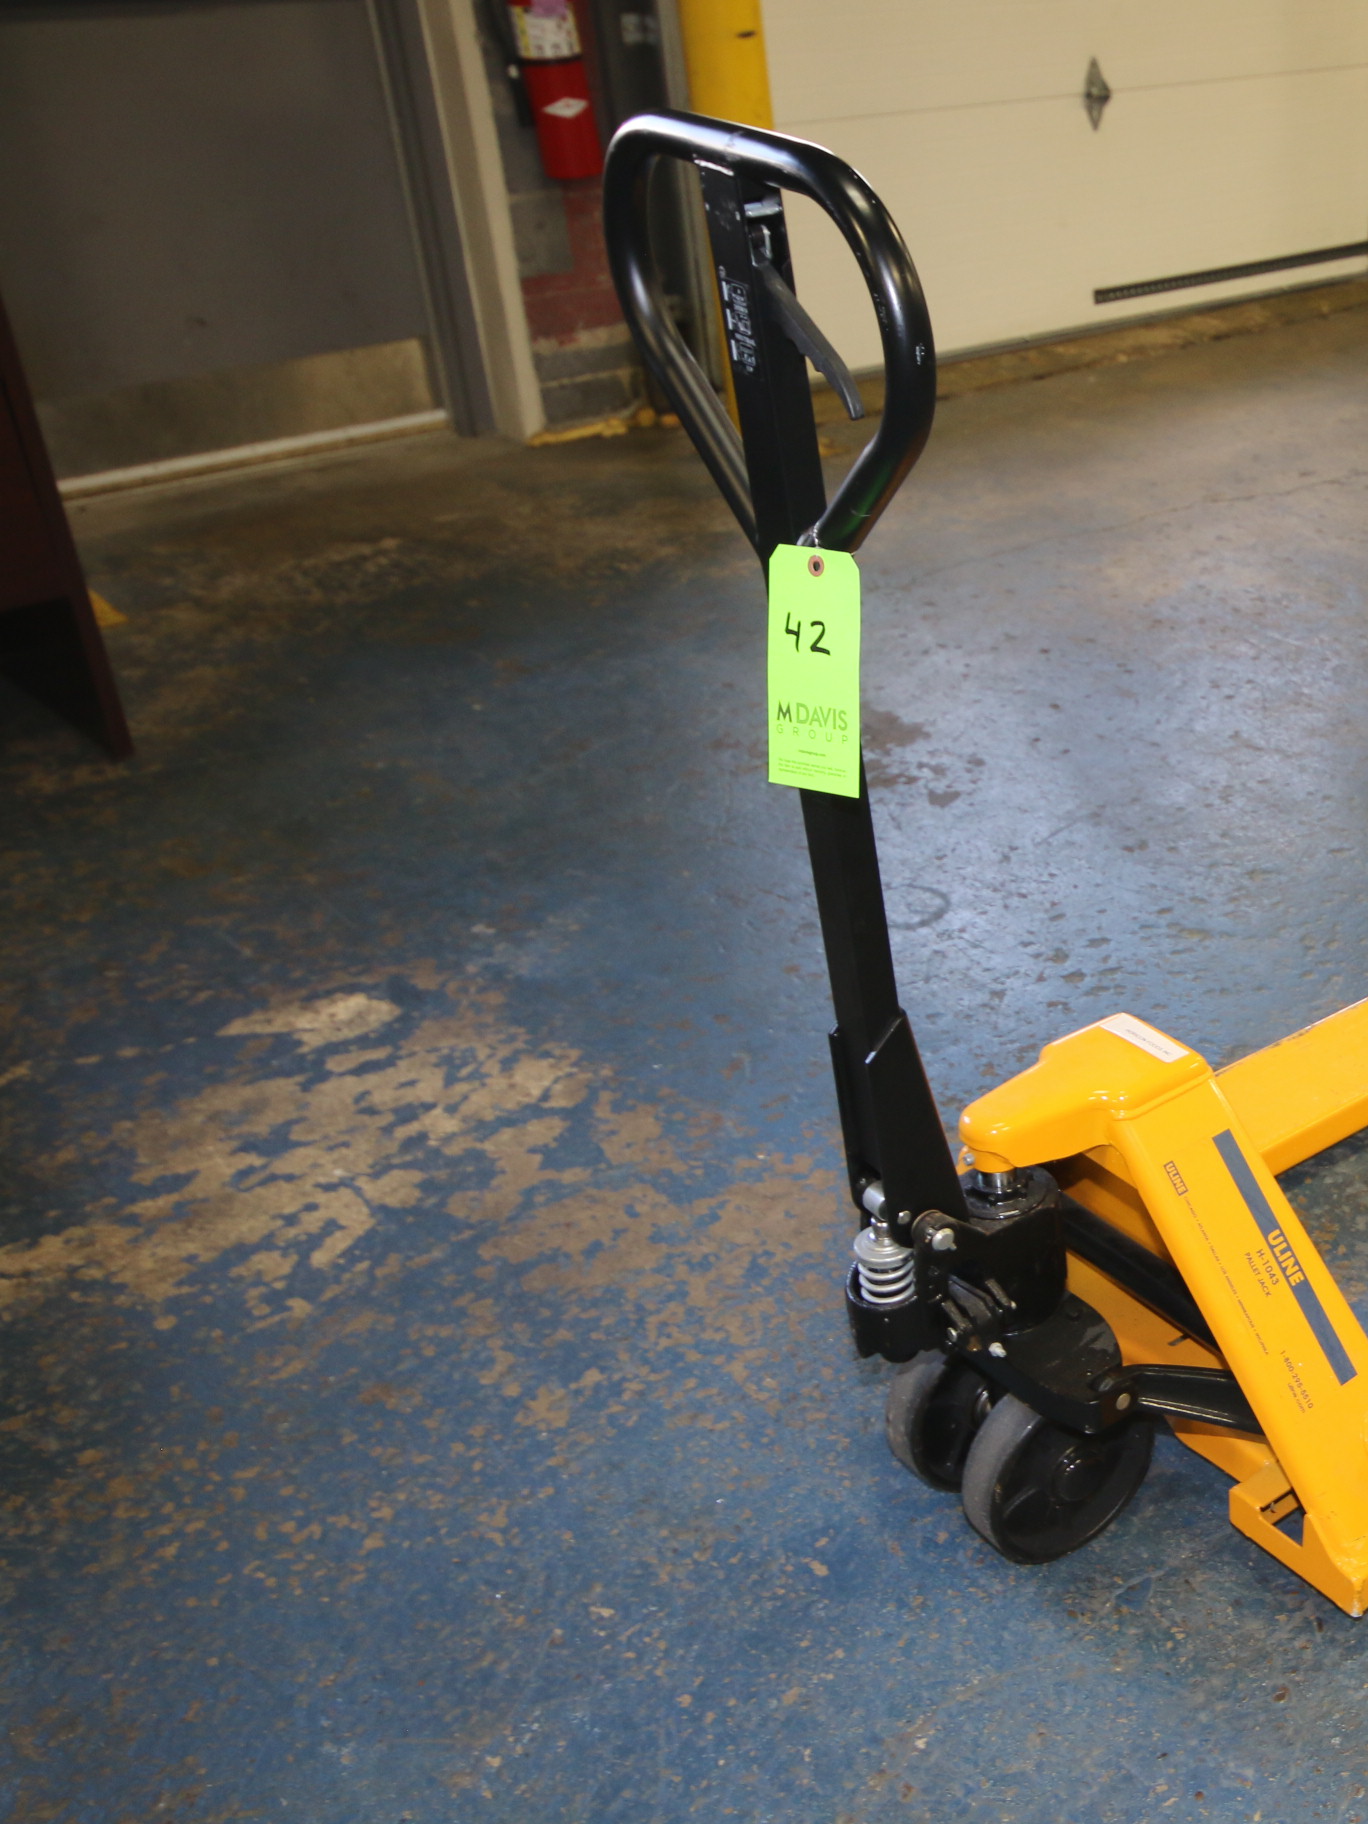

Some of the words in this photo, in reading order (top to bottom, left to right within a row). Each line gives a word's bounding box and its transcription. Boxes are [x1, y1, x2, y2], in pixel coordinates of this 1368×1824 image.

[784, 611, 831, 656] 42
[776, 723, 849, 745] GROUP
[1164, 1161, 1187, 1195] ULINE
[1244, 1252, 1261, 1278] PALLET
[1258, 1278, 1273, 1298] JACK
[1255, 1248, 1281, 1286] H-1043
[1266, 1229, 1305, 1287] ULINE
